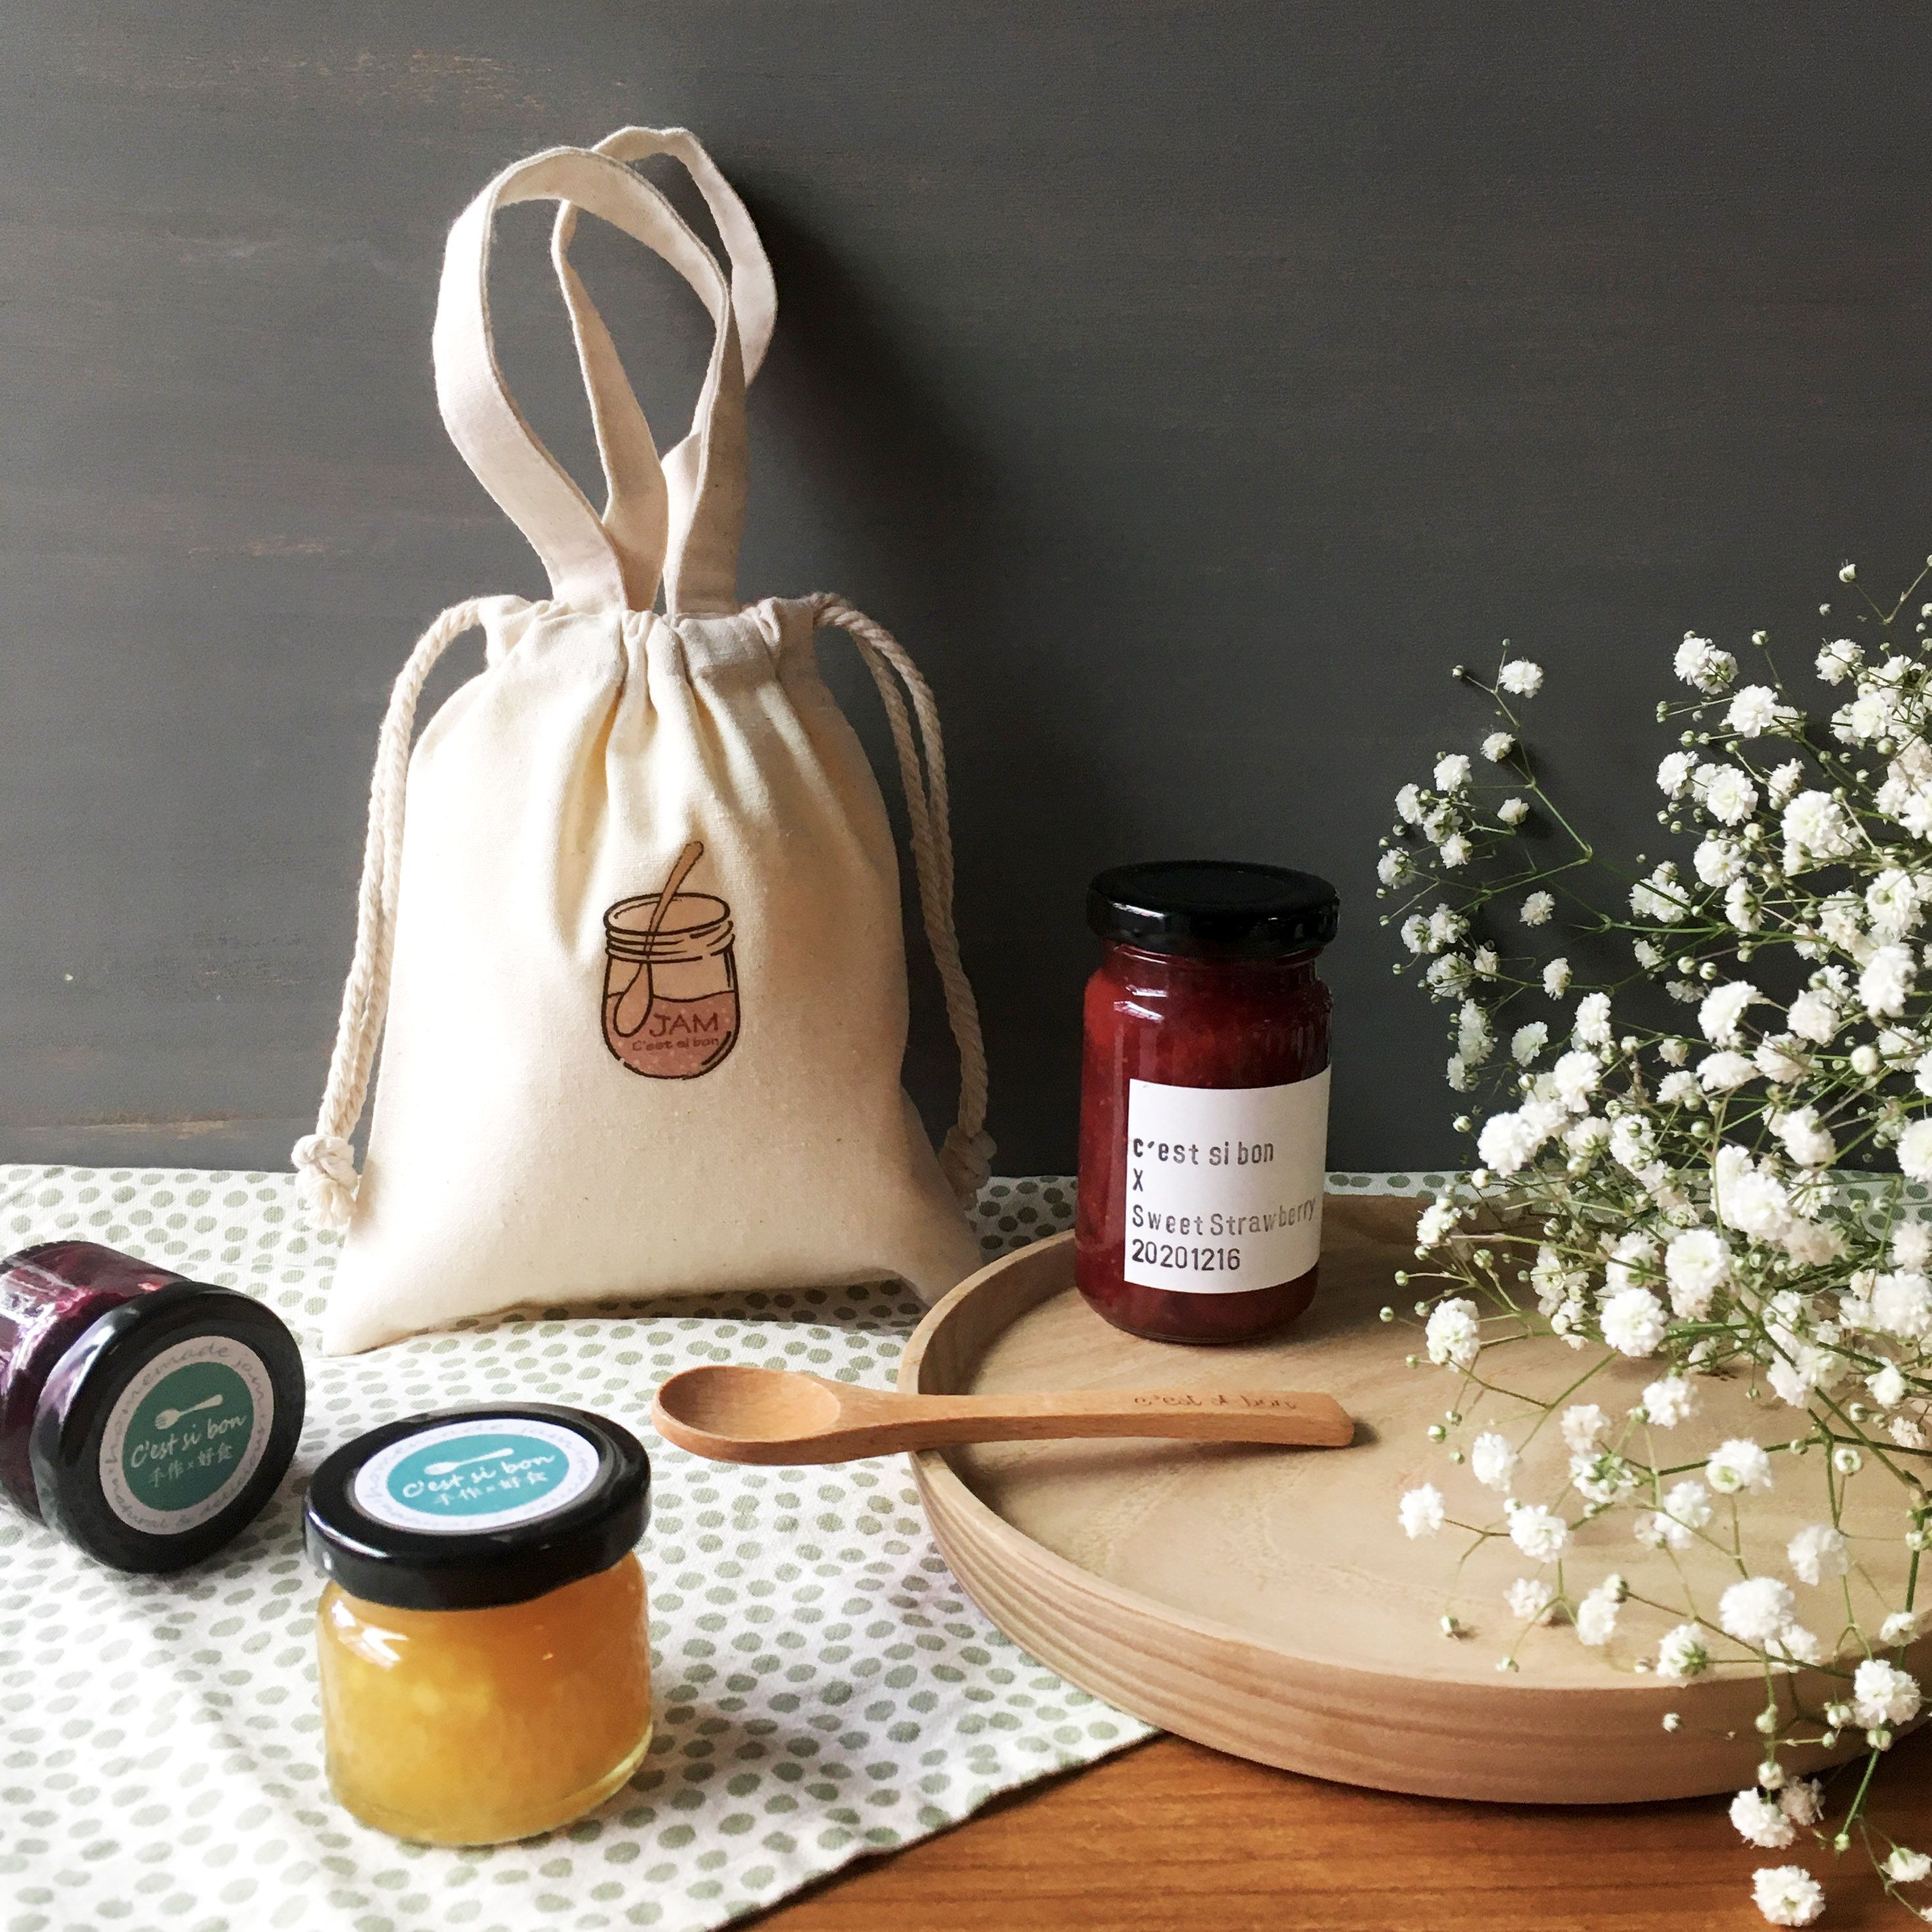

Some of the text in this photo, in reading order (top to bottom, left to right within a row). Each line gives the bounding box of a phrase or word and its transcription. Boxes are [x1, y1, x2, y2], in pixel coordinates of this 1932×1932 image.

[649, 1011, 719, 1037] JAM
[1209, 1141, 1229, 1166] si
[1237, 1141, 1274, 1165] bon
[1132, 1238, 1240, 1271] 20201216
[131, 1414, 248, 1468] C'est si bon
[402, 1455, 556, 1499] C'est si bon
